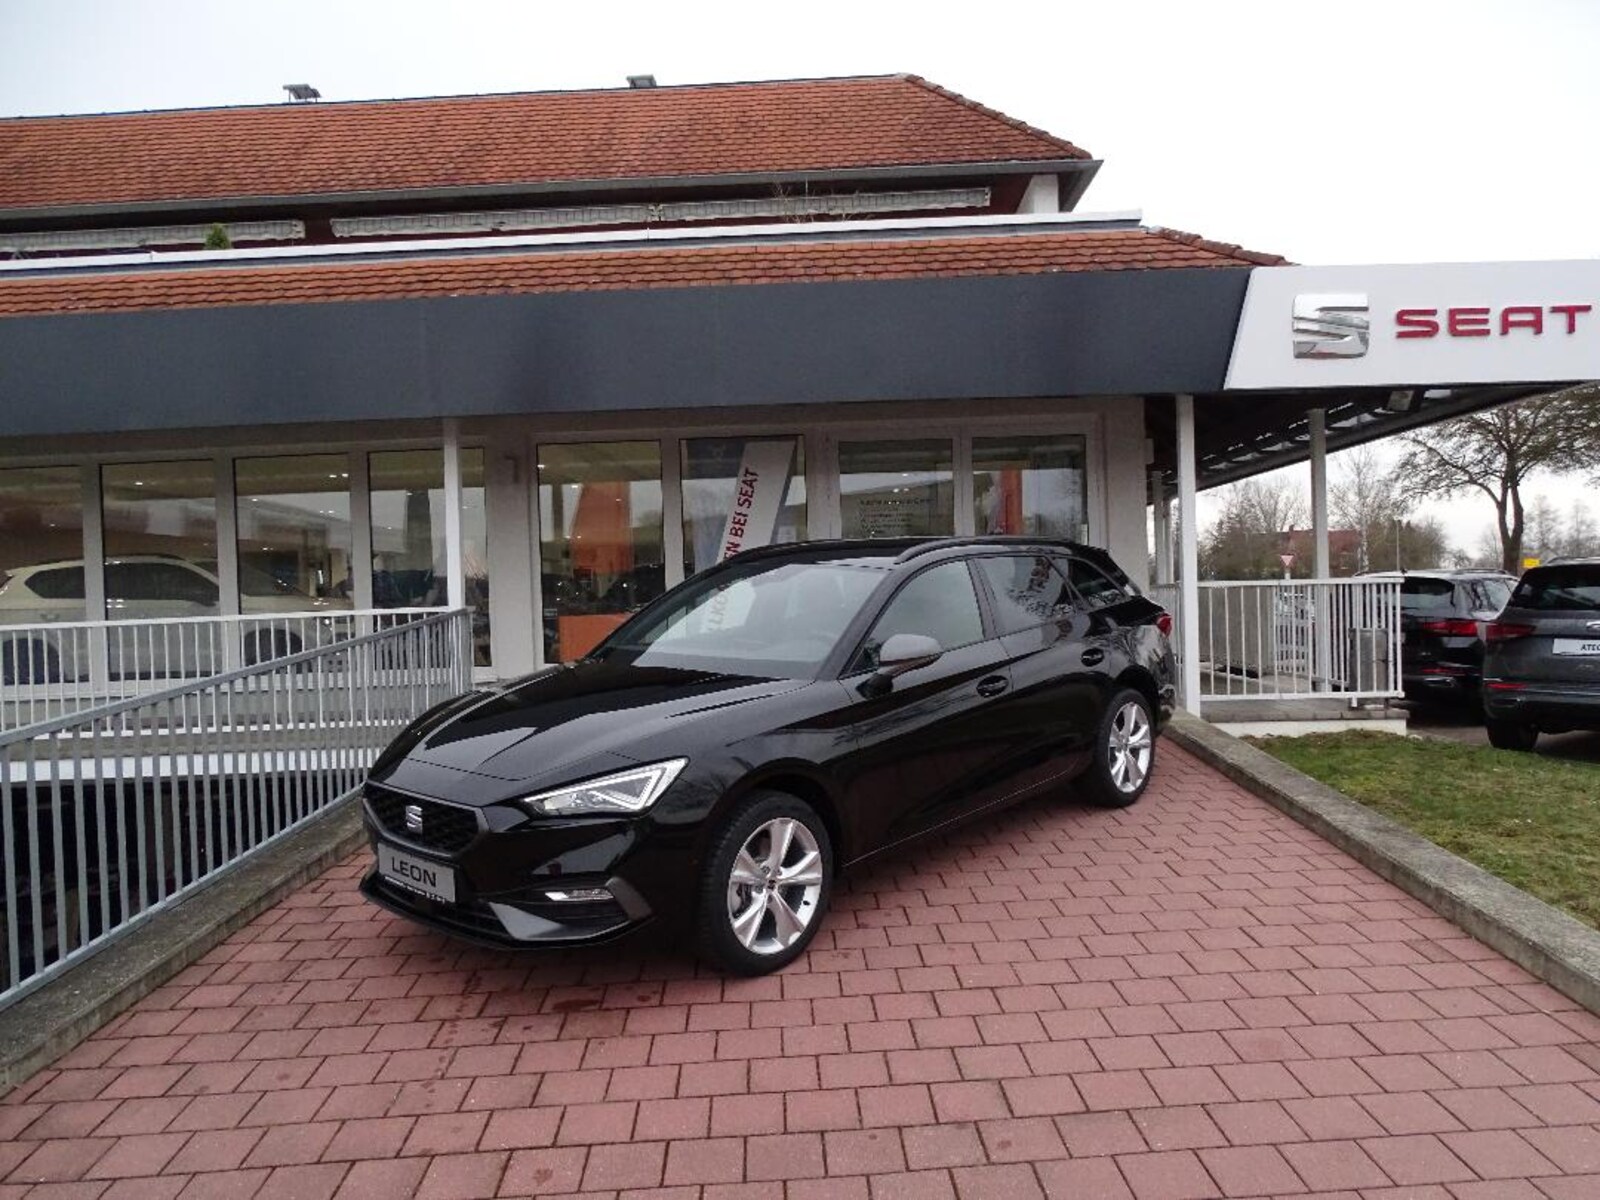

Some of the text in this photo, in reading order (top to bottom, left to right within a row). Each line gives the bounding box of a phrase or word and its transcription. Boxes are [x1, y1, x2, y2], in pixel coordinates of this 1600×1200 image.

[1396, 304, 1592, 339] SEAT
[738, 467, 759, 509] SEAT
[729, 511, 749, 538] BEI
[391, 856, 437, 888] LEON
